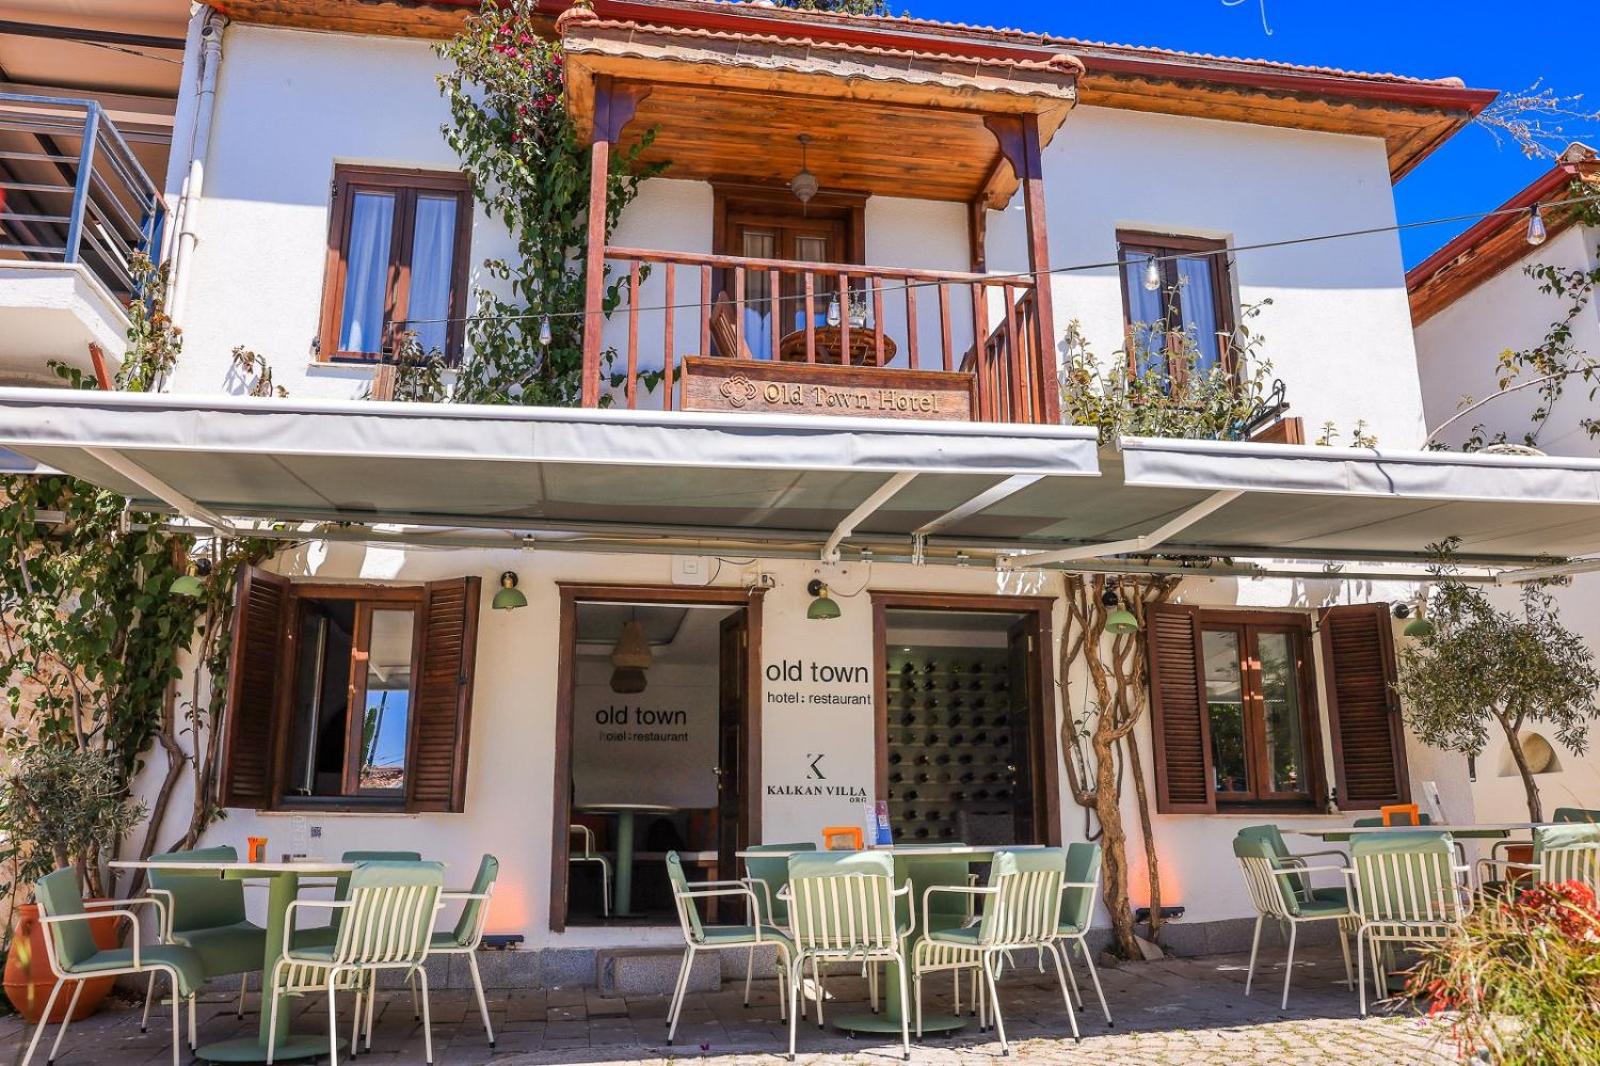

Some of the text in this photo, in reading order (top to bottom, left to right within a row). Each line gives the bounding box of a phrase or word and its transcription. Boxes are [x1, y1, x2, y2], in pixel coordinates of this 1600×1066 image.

[763, 383, 940, 413] Old Town Hotel
[766, 659, 869, 683] old town
[808, 693, 872, 705] restaurant
[595, 705, 687, 725] old town
[633, 731, 689, 742] restaurant
[767, 785, 867, 797] KALKAN VILLA
